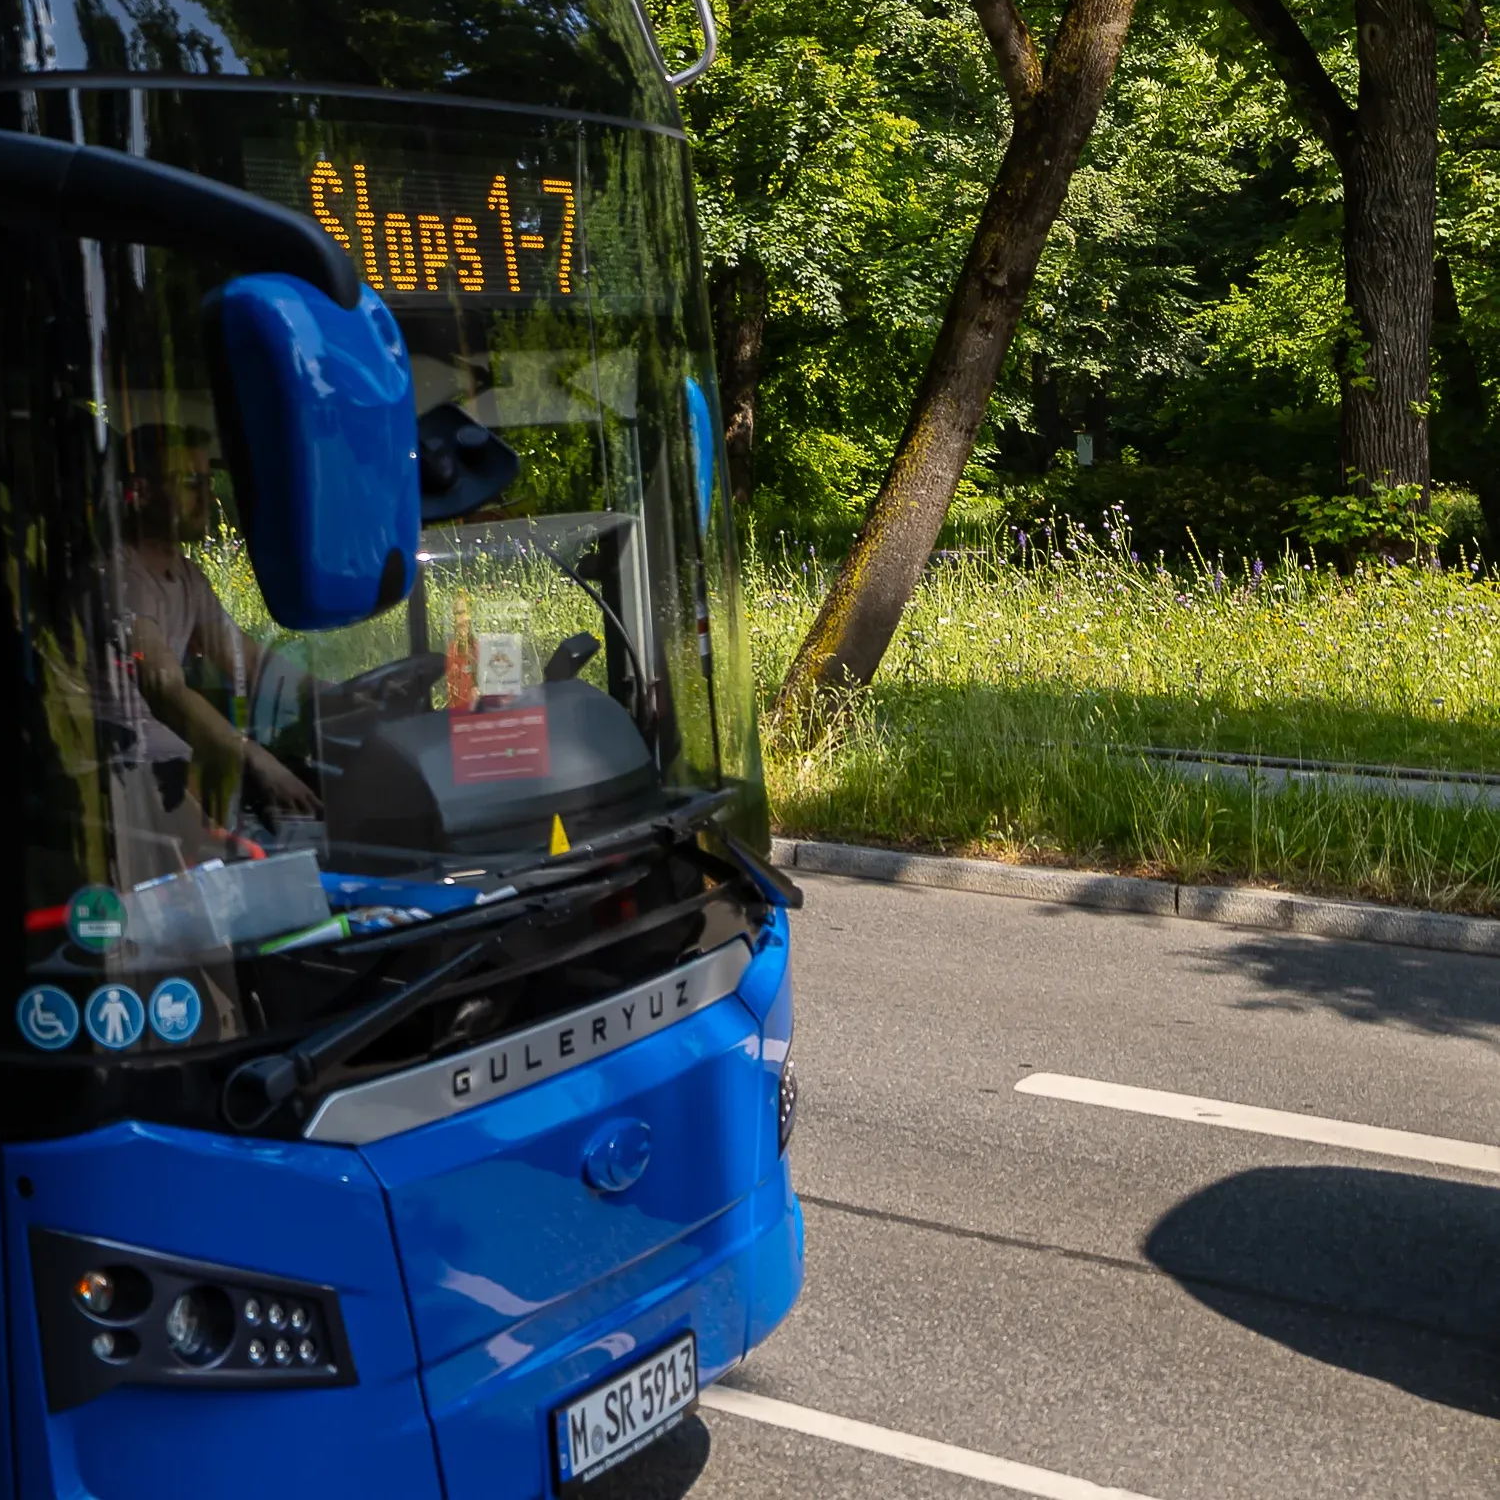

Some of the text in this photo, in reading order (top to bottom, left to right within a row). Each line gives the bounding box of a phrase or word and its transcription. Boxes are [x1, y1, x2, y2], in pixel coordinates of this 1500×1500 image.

[310, 161, 575, 293] Stops 1-7
[452, 980, 688, 1098] GULERYUZ
[571, 1406, 589, 1466] M
[605, 1379, 636, 1444] SR
[640, 1344, 694, 1422] 5913
